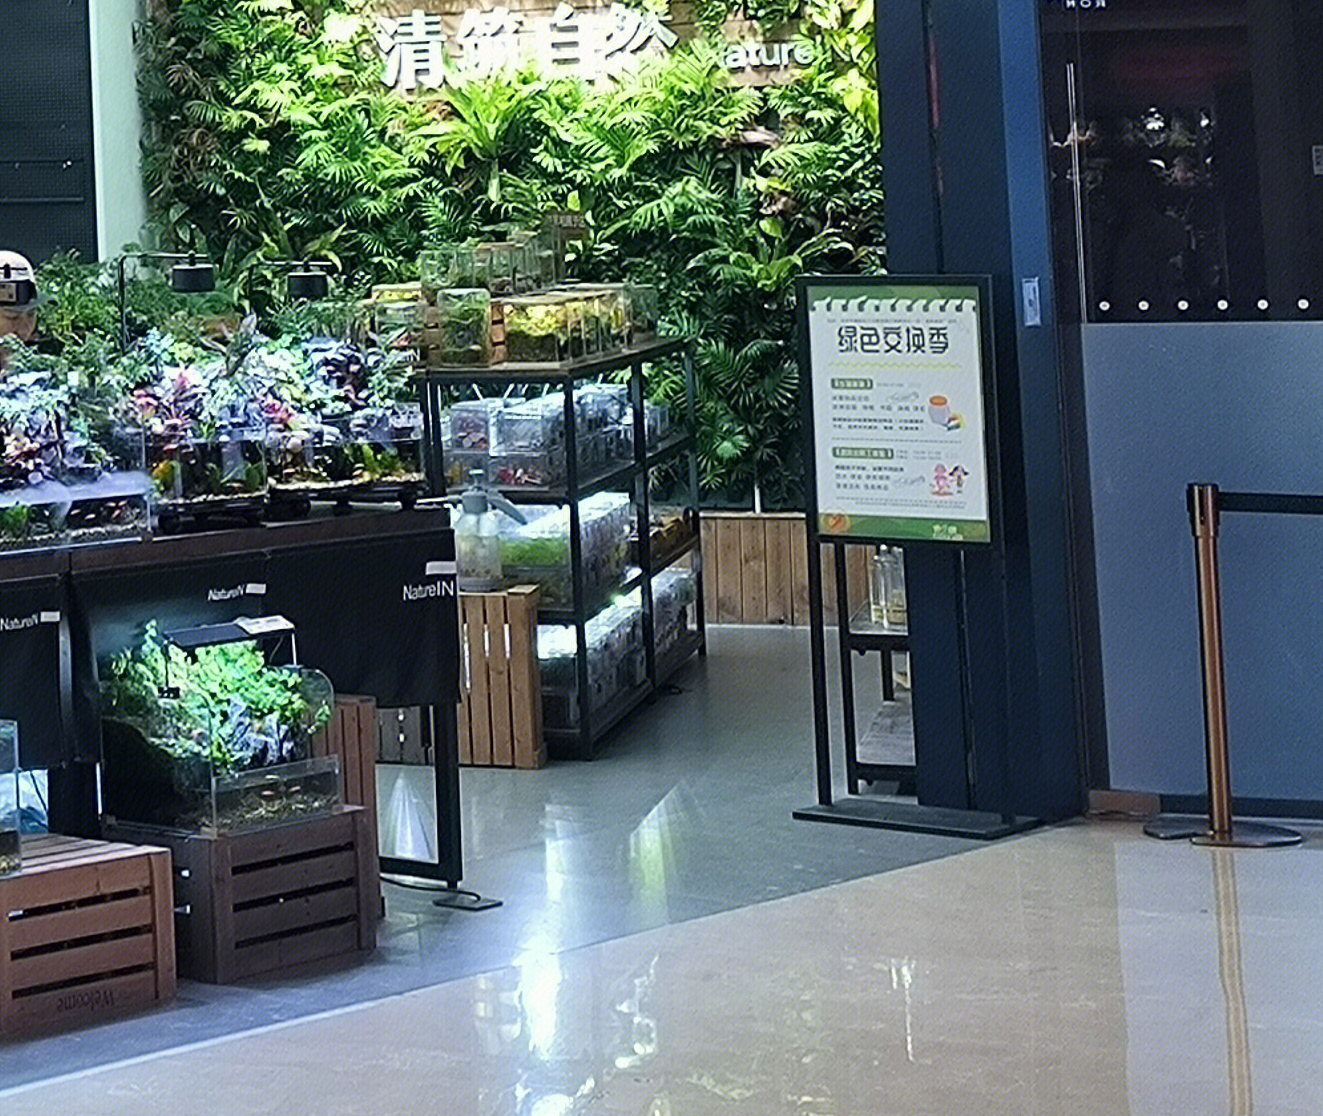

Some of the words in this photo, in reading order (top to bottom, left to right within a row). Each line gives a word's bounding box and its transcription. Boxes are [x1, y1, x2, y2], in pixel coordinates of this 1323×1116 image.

[837, 326, 950, 354] 绿色交换季
[403, 580, 454, 601] NatureIN
